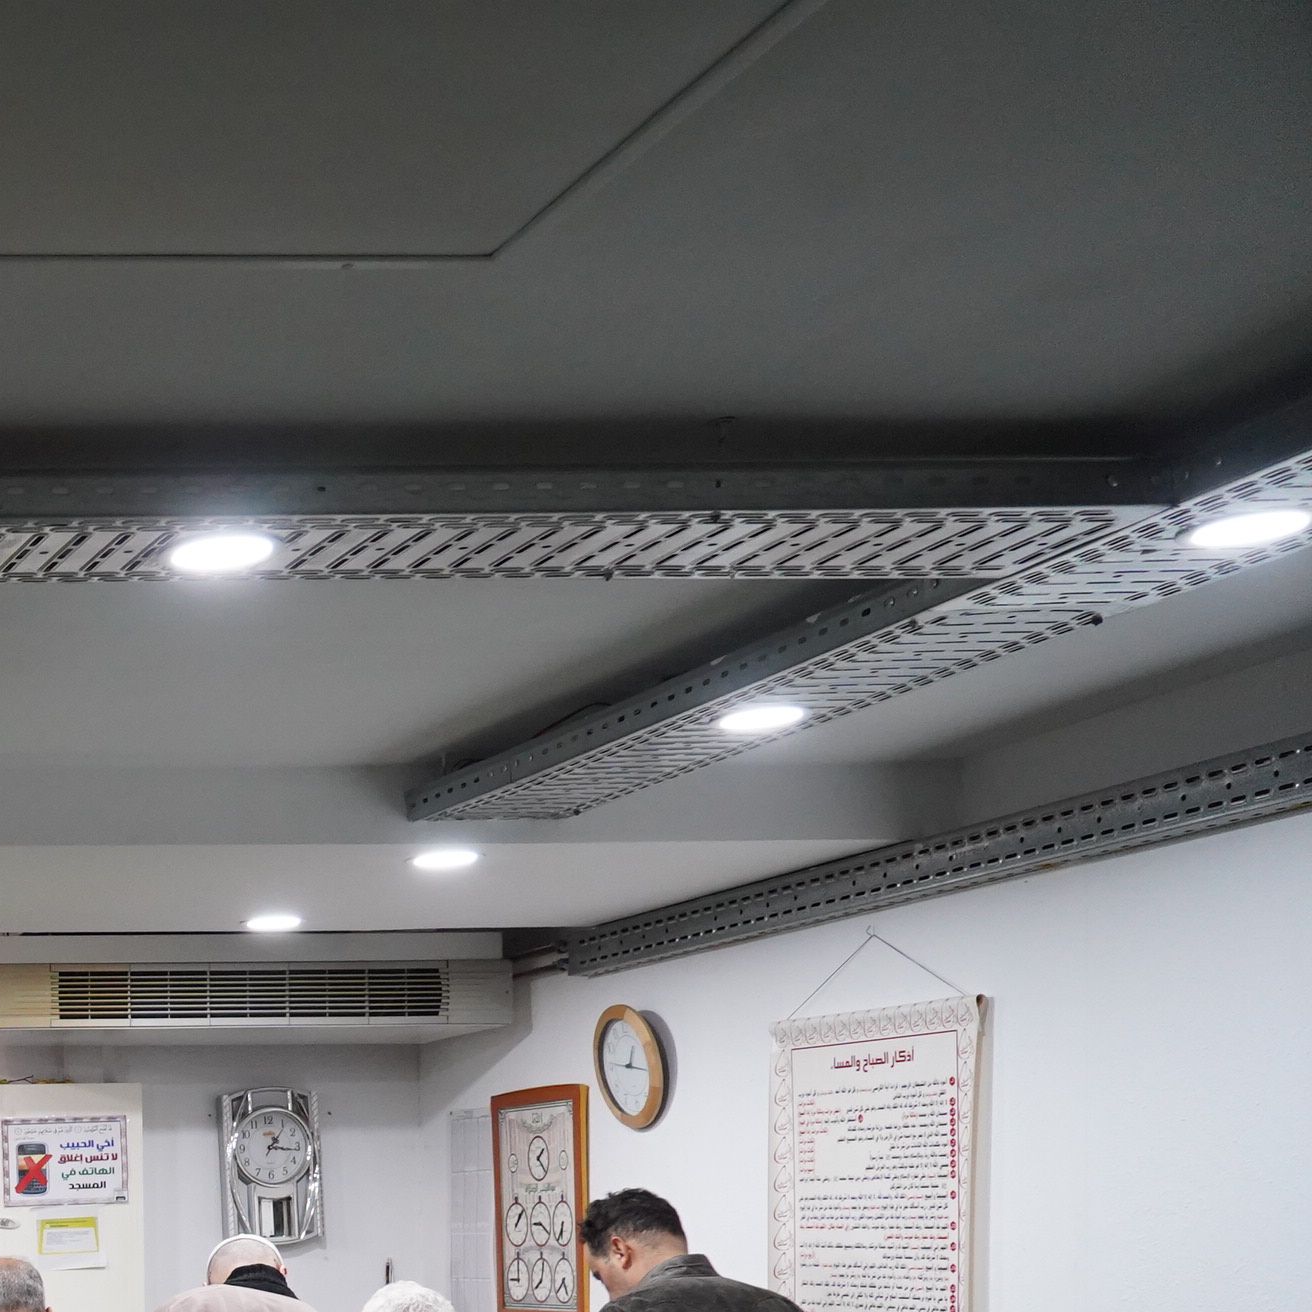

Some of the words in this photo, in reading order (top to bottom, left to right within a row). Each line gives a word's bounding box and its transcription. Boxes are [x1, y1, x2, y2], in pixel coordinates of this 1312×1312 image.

[862, 1052, 888, 1072] الصباح
[250, 1120, 257, 1129] 11
[263, 1116, 273, 1124] 12
[242, 1130, 250, 1139] 10
[290, 1128, 296, 1136] 2
[60, 1140, 94, 1150] الحبيب
[96, 1137, 114, 1152] أخي
[239, 1144, 245, 1153] 9
[295, 1142, 300, 1151] 3
[86, 1153, 109, 1163] تنس
[244, 1158, 250, 1166] 8
[290, 1156, 296, 1164] 4
[62, 1168, 76, 1180] في
[78, 1167, 115, 1176] الهاتف
[256, 1168, 261, 1176] 7
[269, 1170, 274, 1179] 6
[282, 1167, 288, 1175] 5
[68, 1181, 106, 1192] المسجد
